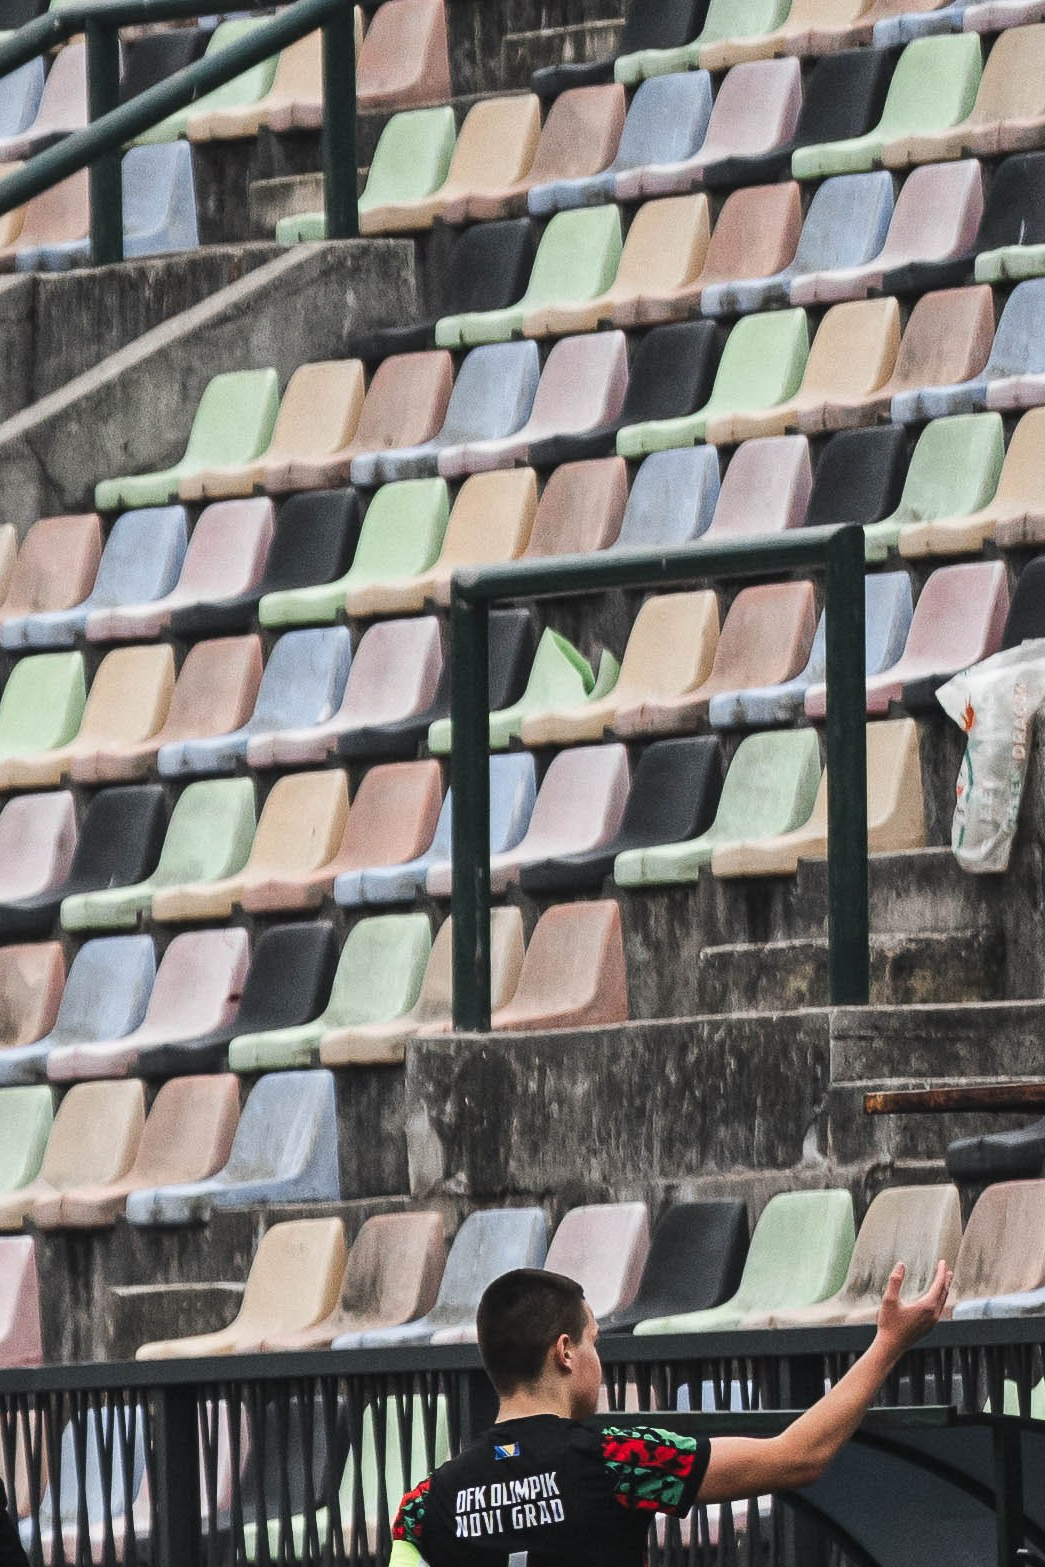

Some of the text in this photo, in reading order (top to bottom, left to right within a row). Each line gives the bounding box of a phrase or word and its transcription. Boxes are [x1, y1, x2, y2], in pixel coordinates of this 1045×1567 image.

[490, 1471, 560, 1507] OLIMPIK
[455, 1499, 565, 1538] NOVI GRAD
